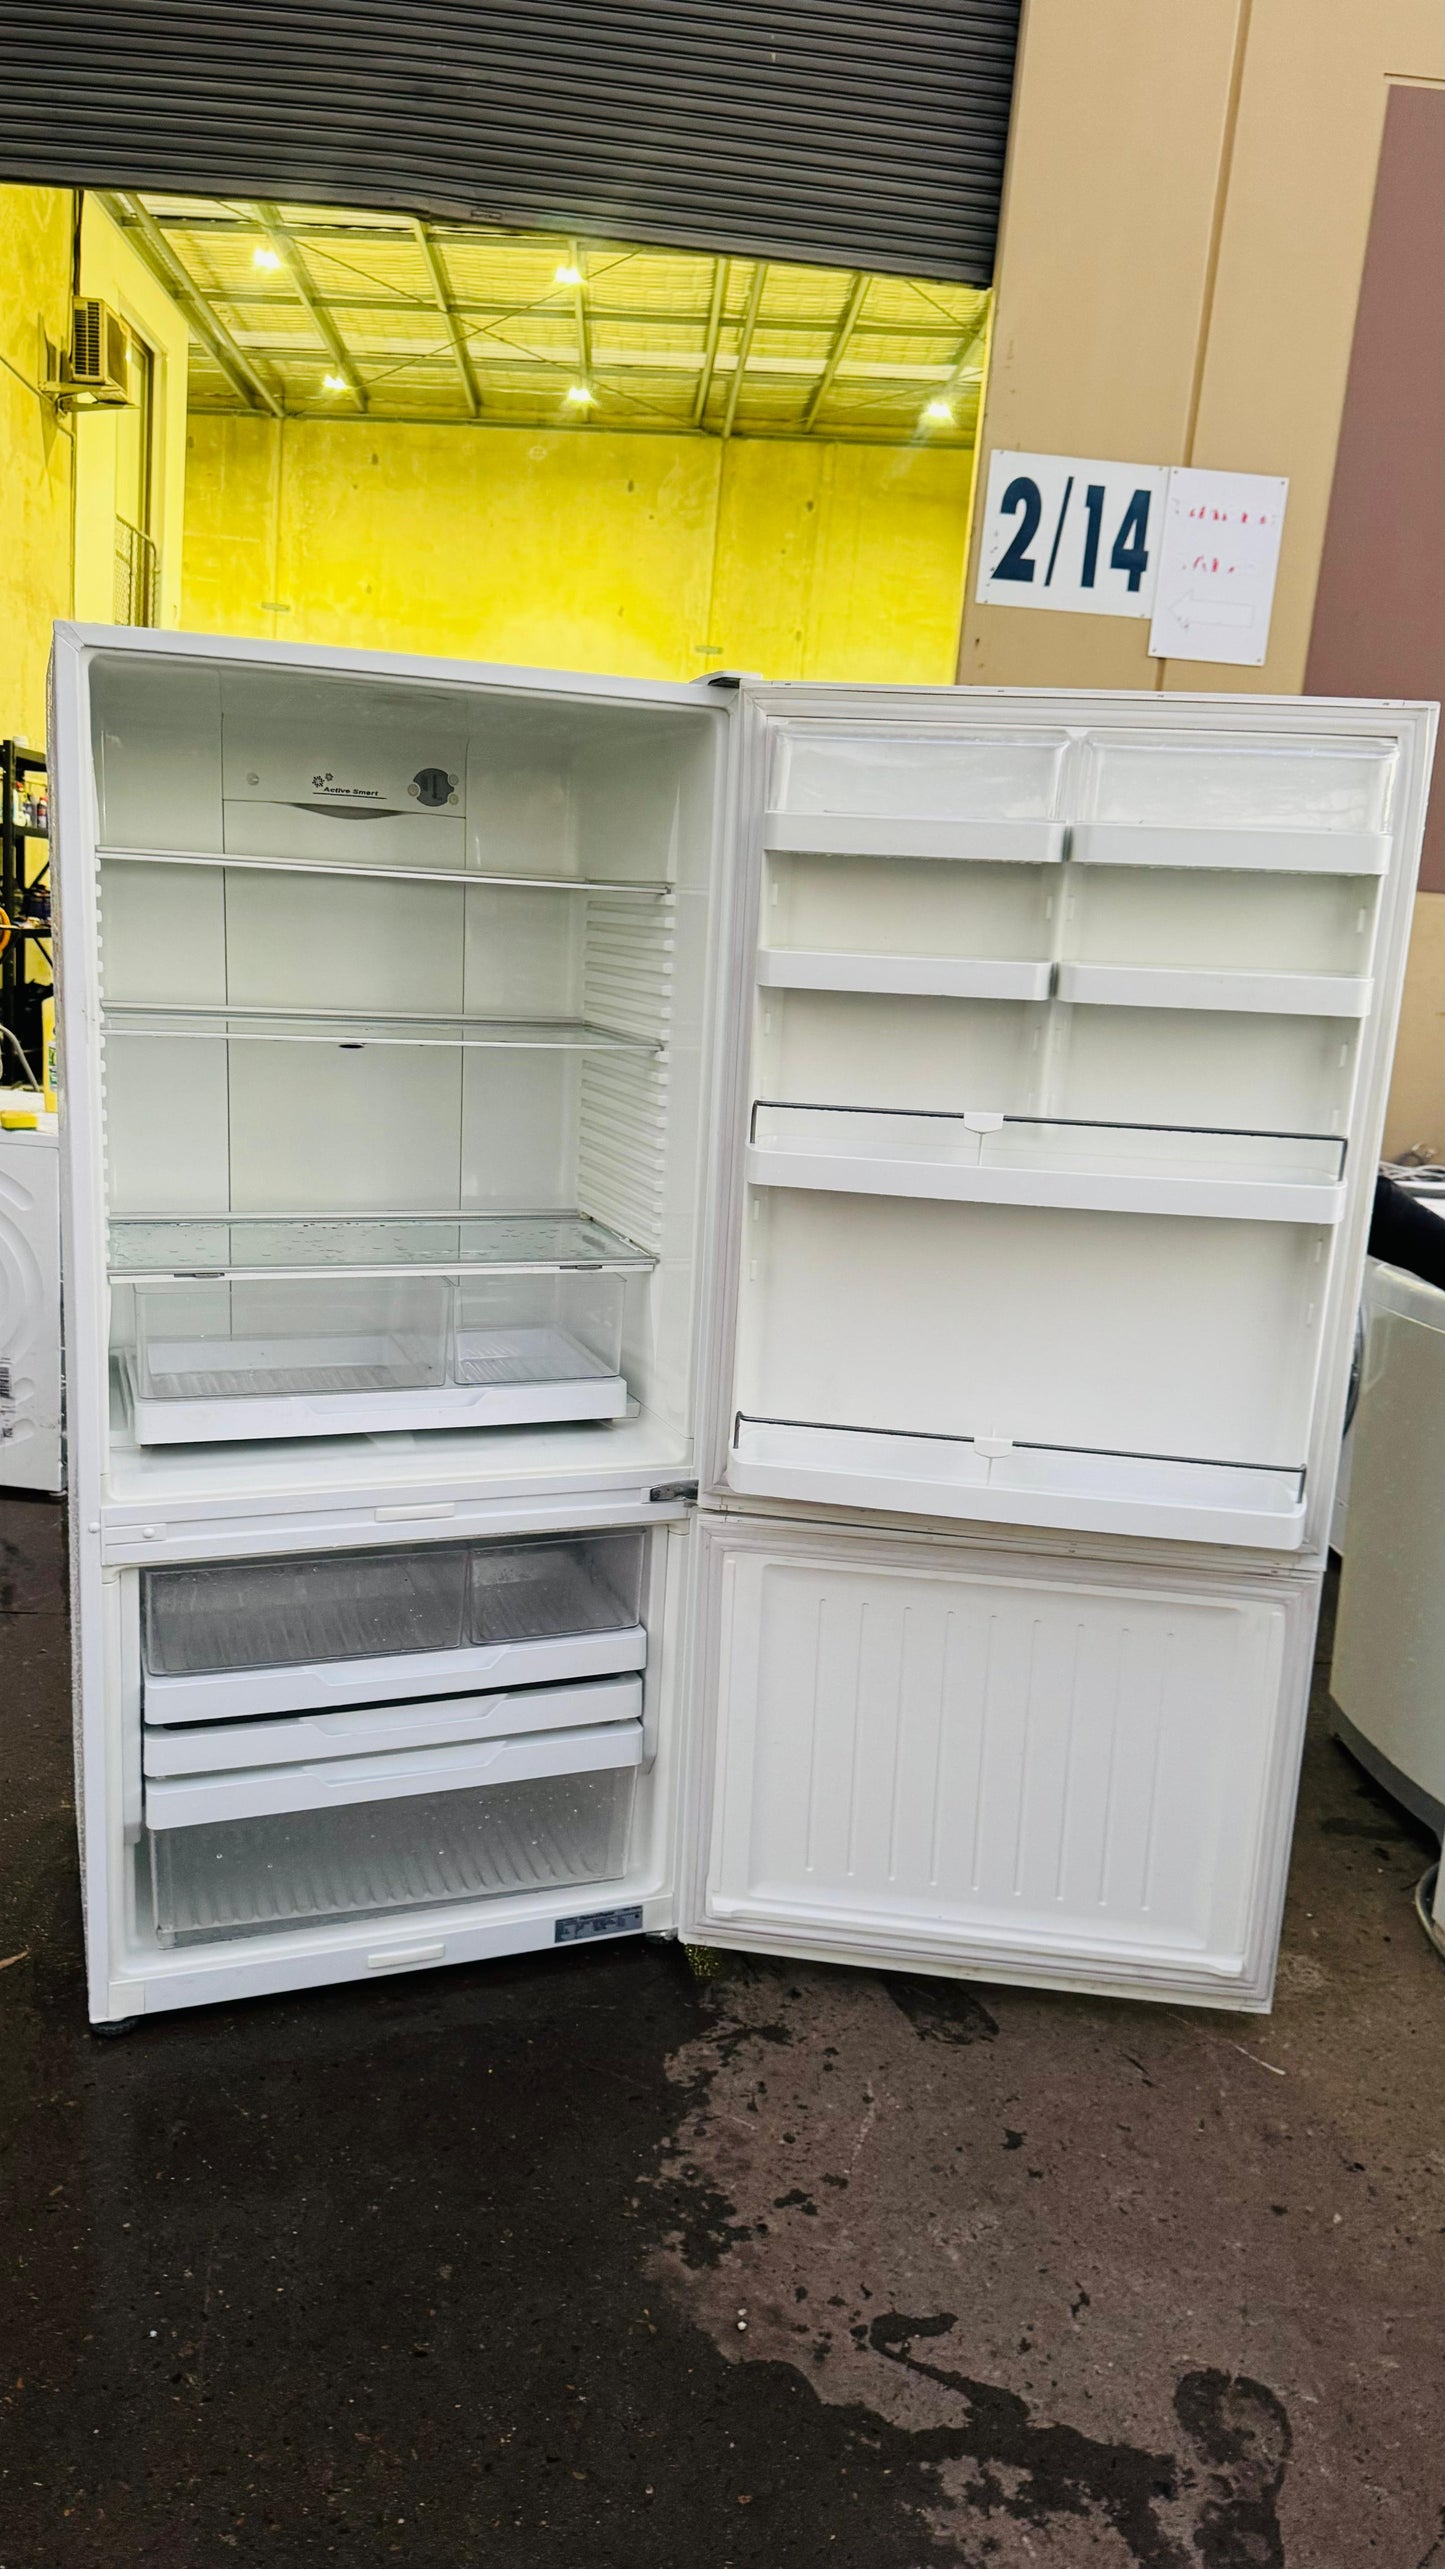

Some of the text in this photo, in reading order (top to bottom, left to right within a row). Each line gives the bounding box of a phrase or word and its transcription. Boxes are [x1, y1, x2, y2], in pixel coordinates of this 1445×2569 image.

[990, 476, 1151, 592] 2/14
[323, 786, 379, 796] Active Smart
